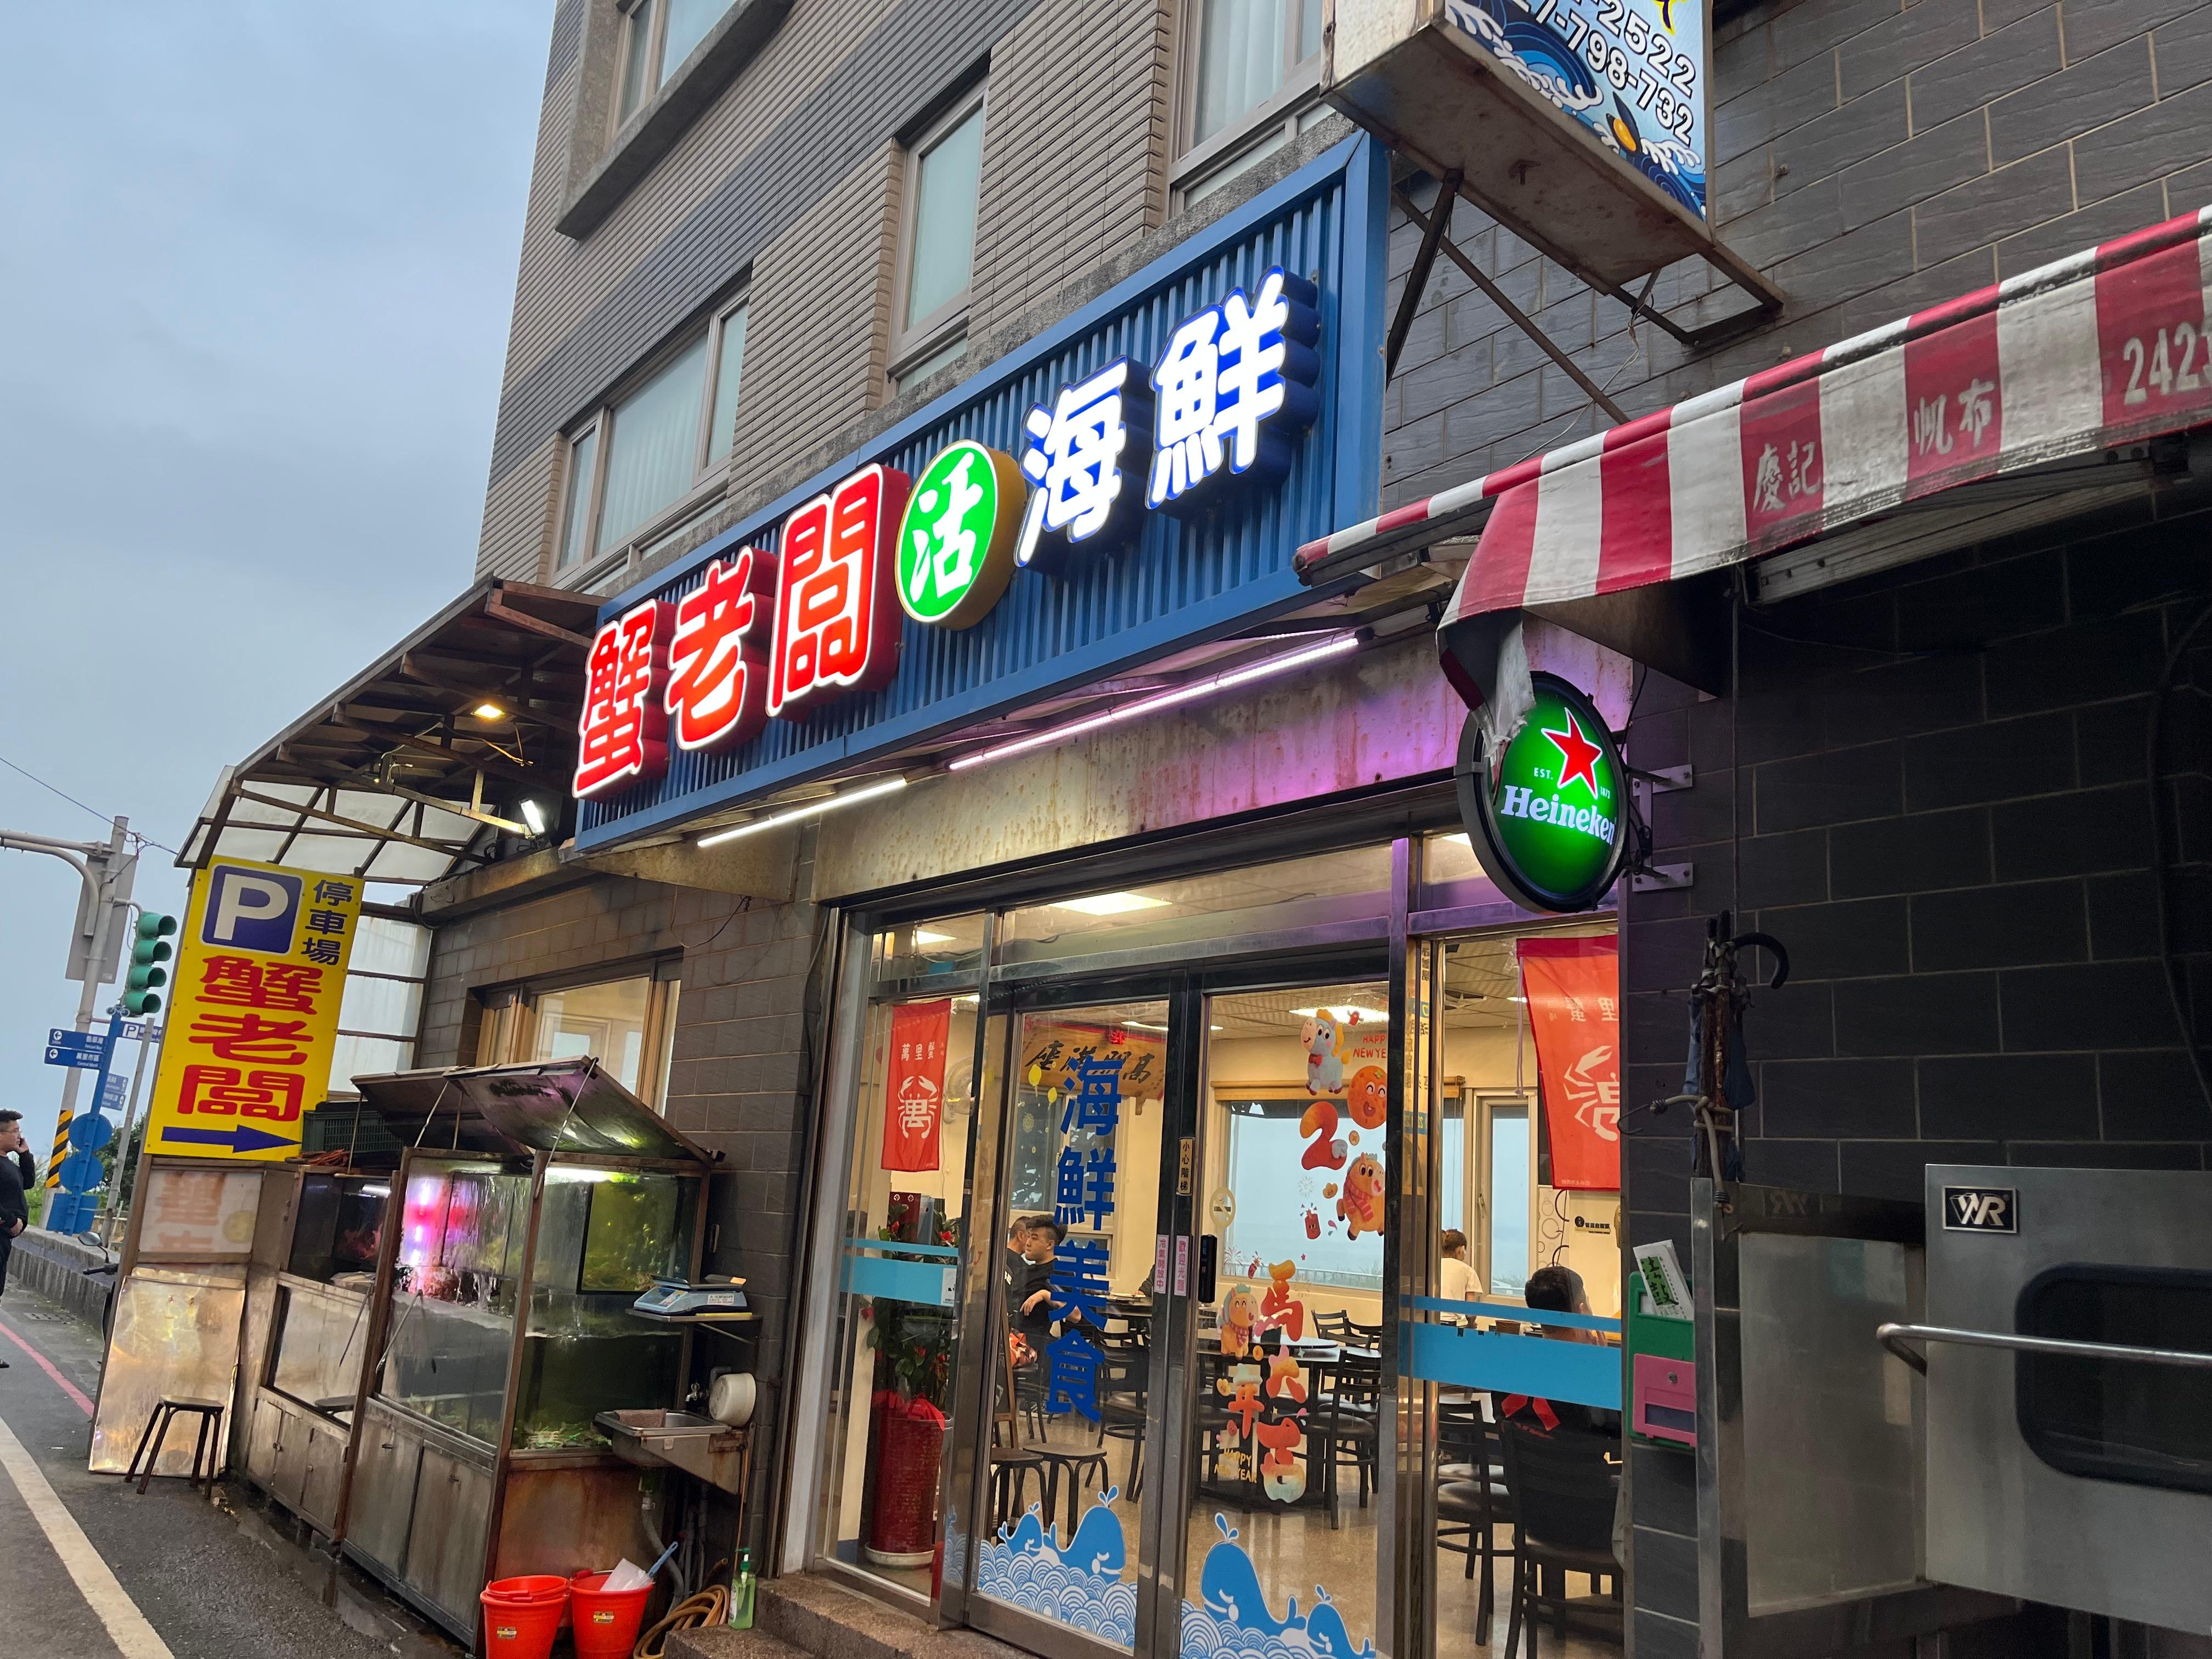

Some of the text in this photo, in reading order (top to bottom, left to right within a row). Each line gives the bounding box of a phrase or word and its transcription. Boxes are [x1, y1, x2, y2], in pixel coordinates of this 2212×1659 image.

[1572, 0, 1696, 99] 2522
[1533, 767, 1611, 800] EST. 1873
[1500, 785, 1615, 846] Heineken
[214, 873, 289, 941] P
[301, 879, 354, 966] 停車場
[177, 955, 323, 1122] 蟹老闆
[1353, 1047, 1386, 1059] NEW YE
[1363, 1034, 1387, 1044] HAPP
[1180, 1141, 1190, 1191] 小心階梯
[1045, 1054, 1123, 1424] 海鮮美食
[1156, 1239, 1167, 1289] 冷氣開放中
[1177, 1240, 1187, 1291] 歡迎光臨
